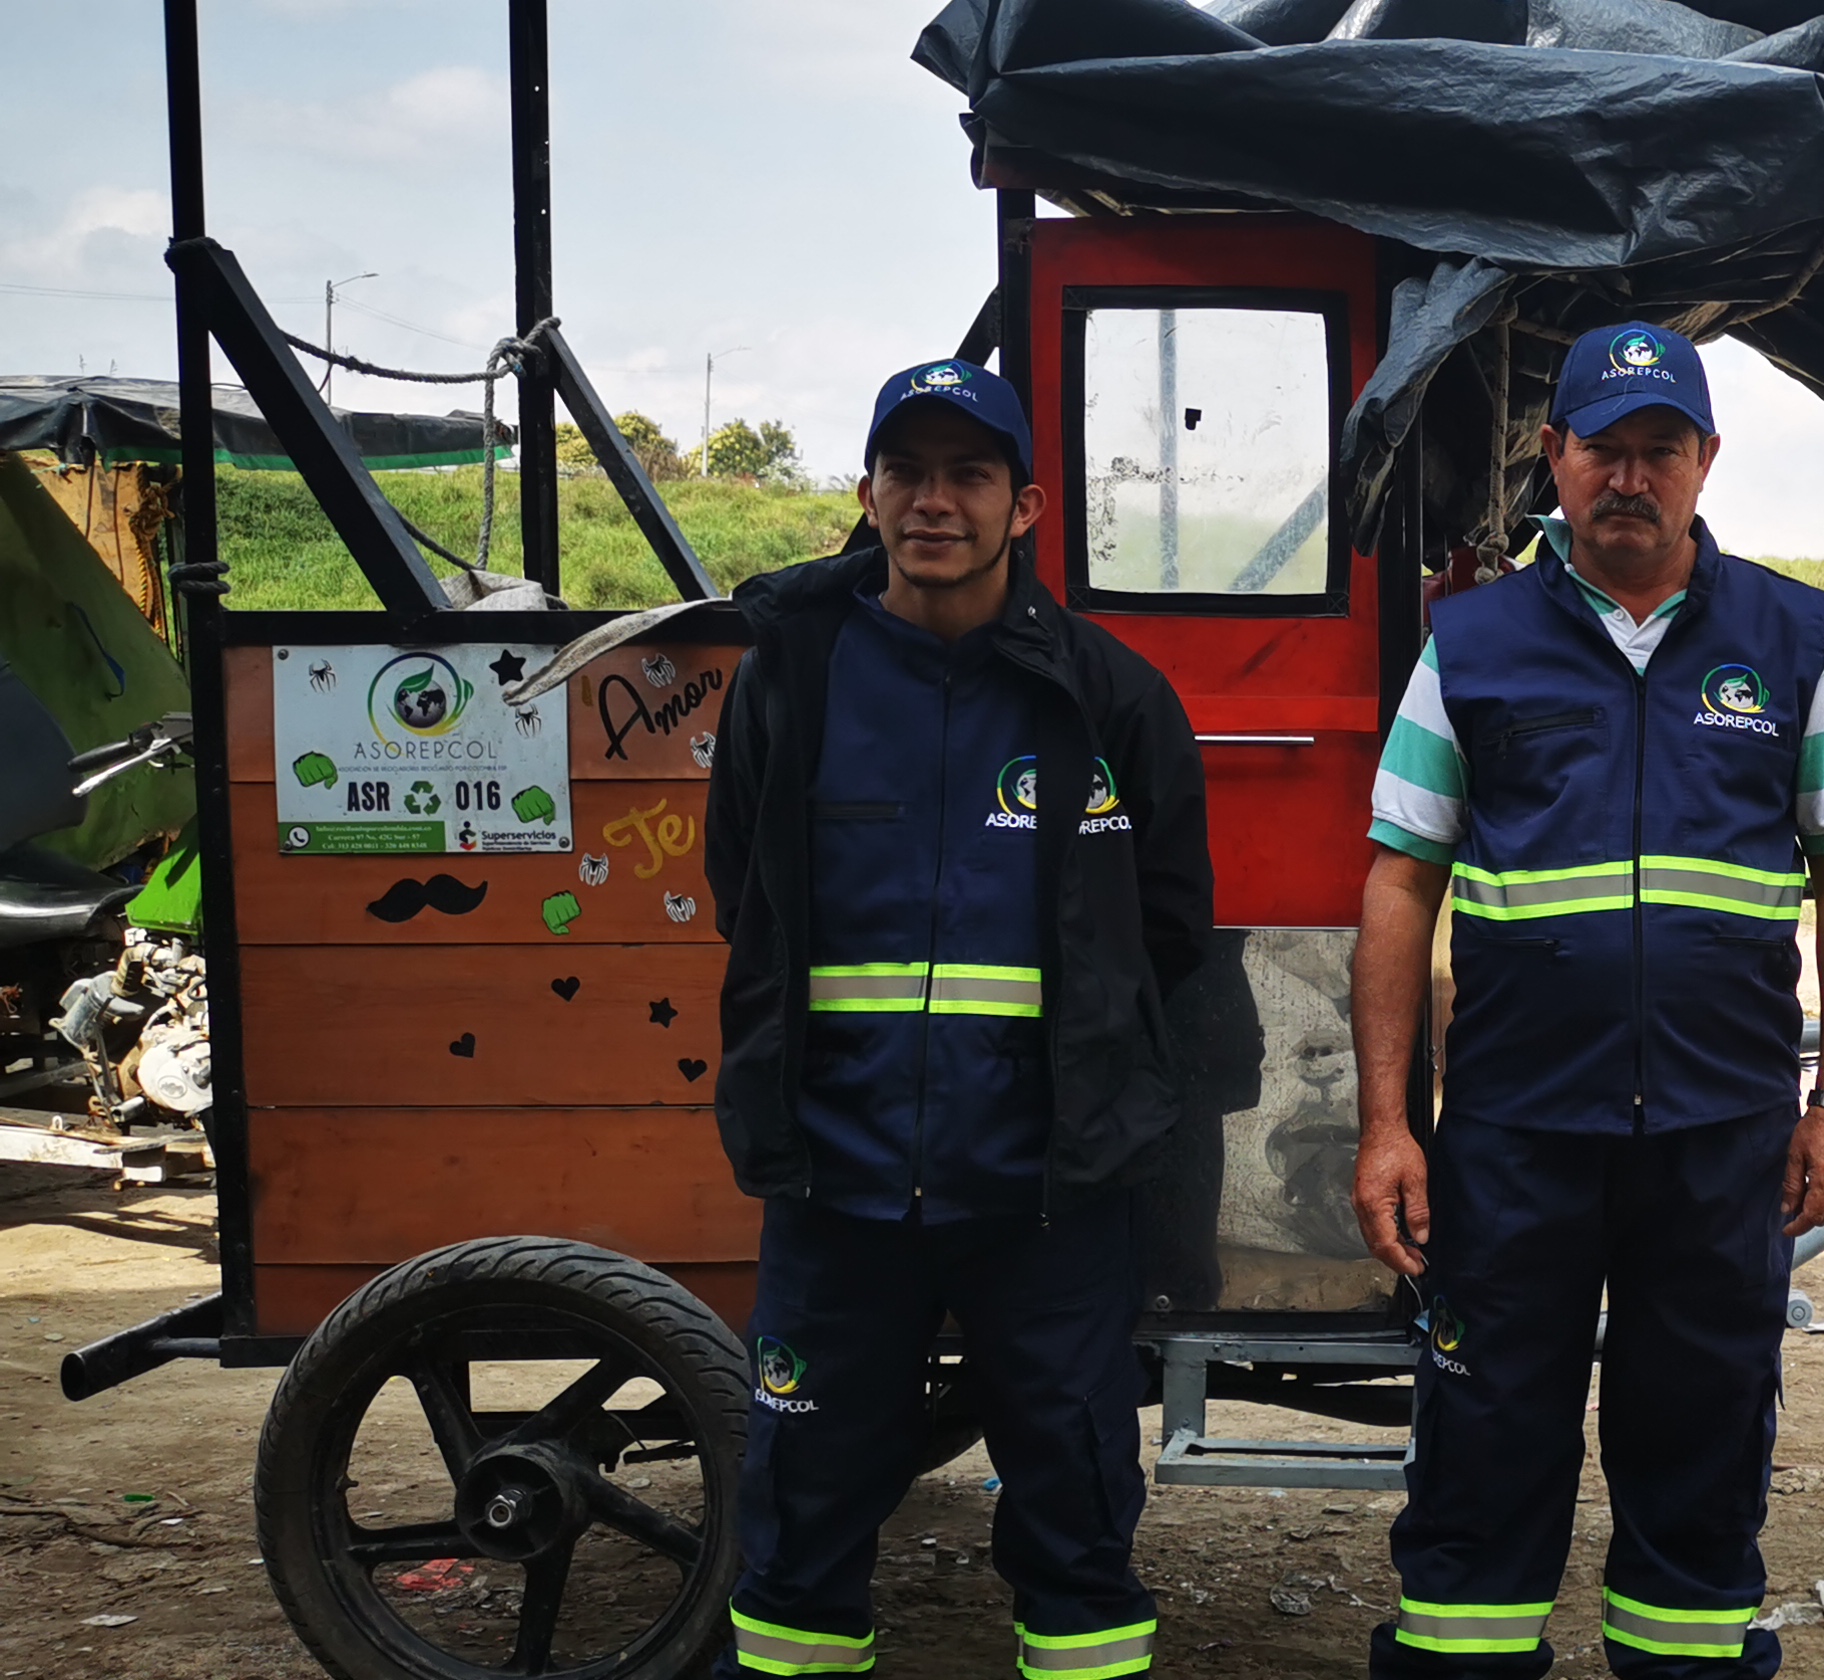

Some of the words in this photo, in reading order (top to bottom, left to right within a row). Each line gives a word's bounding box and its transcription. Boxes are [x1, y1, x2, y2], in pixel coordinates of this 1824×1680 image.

[1601, 366, 1678, 384] ASOREPCOL
[899, 385, 979, 402] ASOREPCOL
[597, 667, 724, 761] Amor
[1693, 711, 1780, 737] ASOREPCOL
[353, 740, 498, 760] ASOREPCOL
[346, 781, 391, 812] ASR
[455, 780, 502, 811] 016
[481, 830, 557, 843] Superservicios
[603, 797, 696, 880] Te
